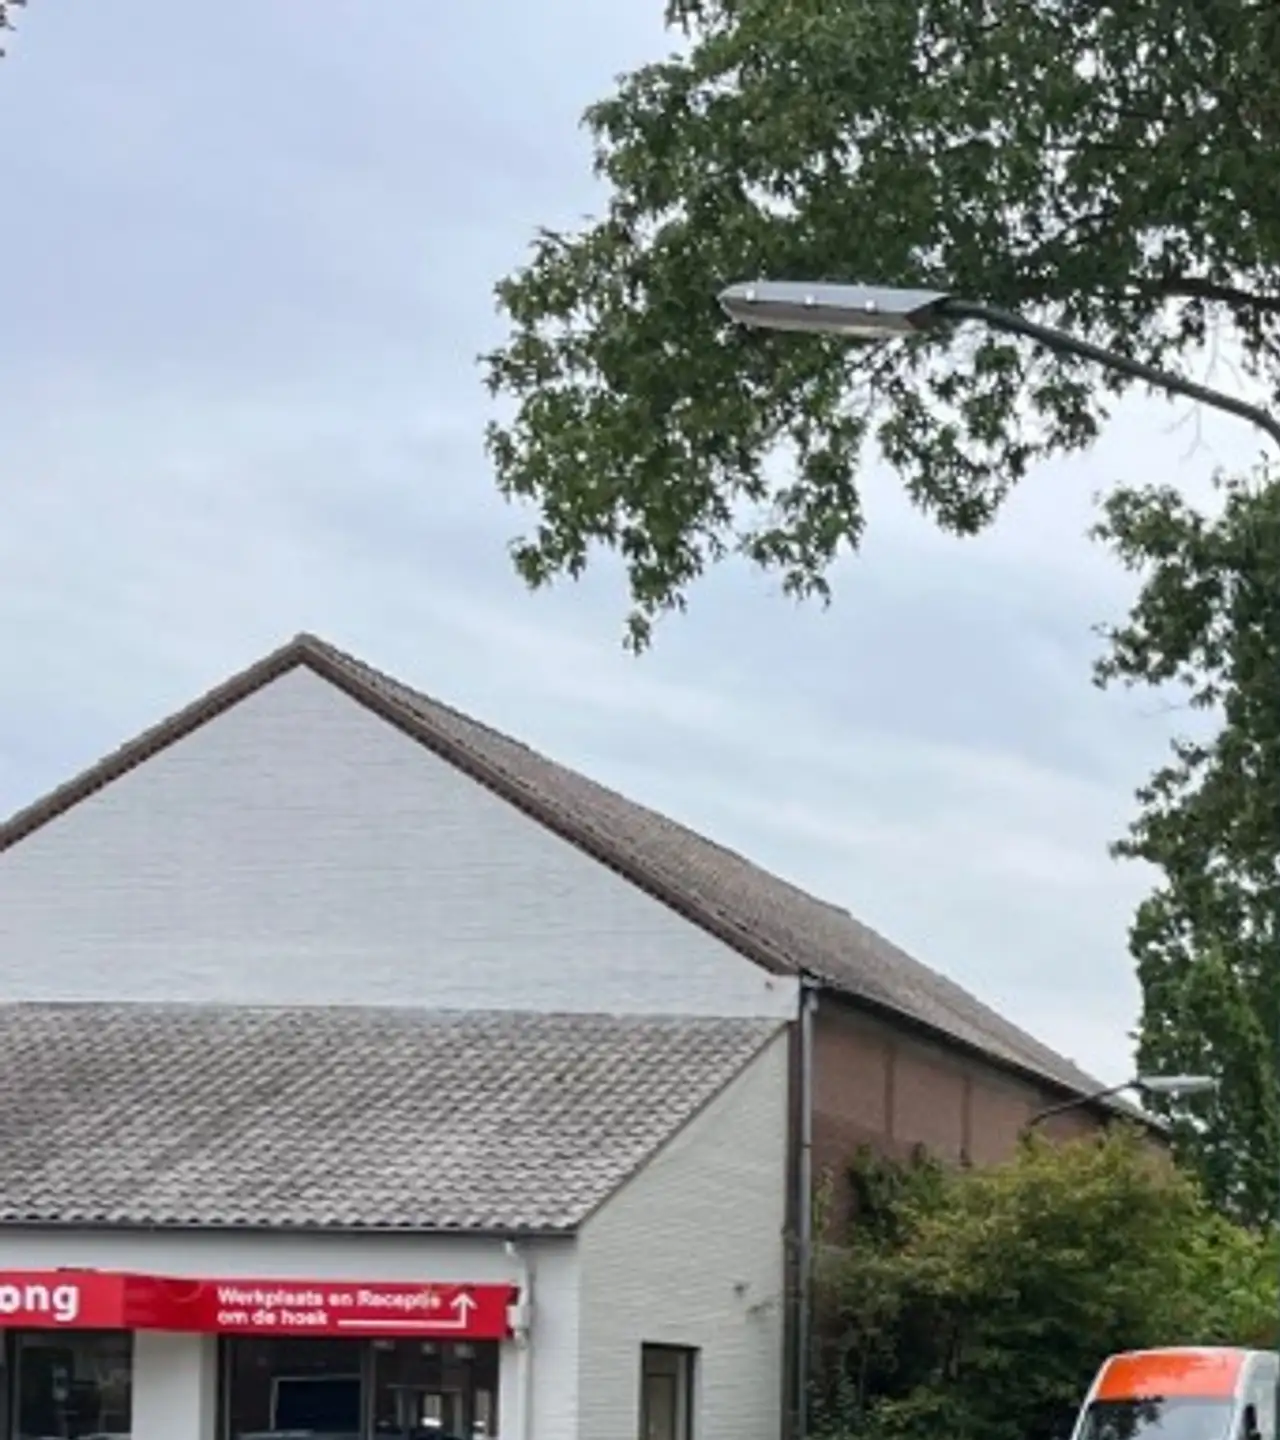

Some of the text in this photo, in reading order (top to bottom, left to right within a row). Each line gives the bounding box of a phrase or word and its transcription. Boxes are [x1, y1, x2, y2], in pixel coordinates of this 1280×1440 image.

[0, 1284, 80, 1322] ong
[217, 1286, 441, 1312] Werkplaats en Receptie
[217, 1309, 328, 1325] om de hoek
